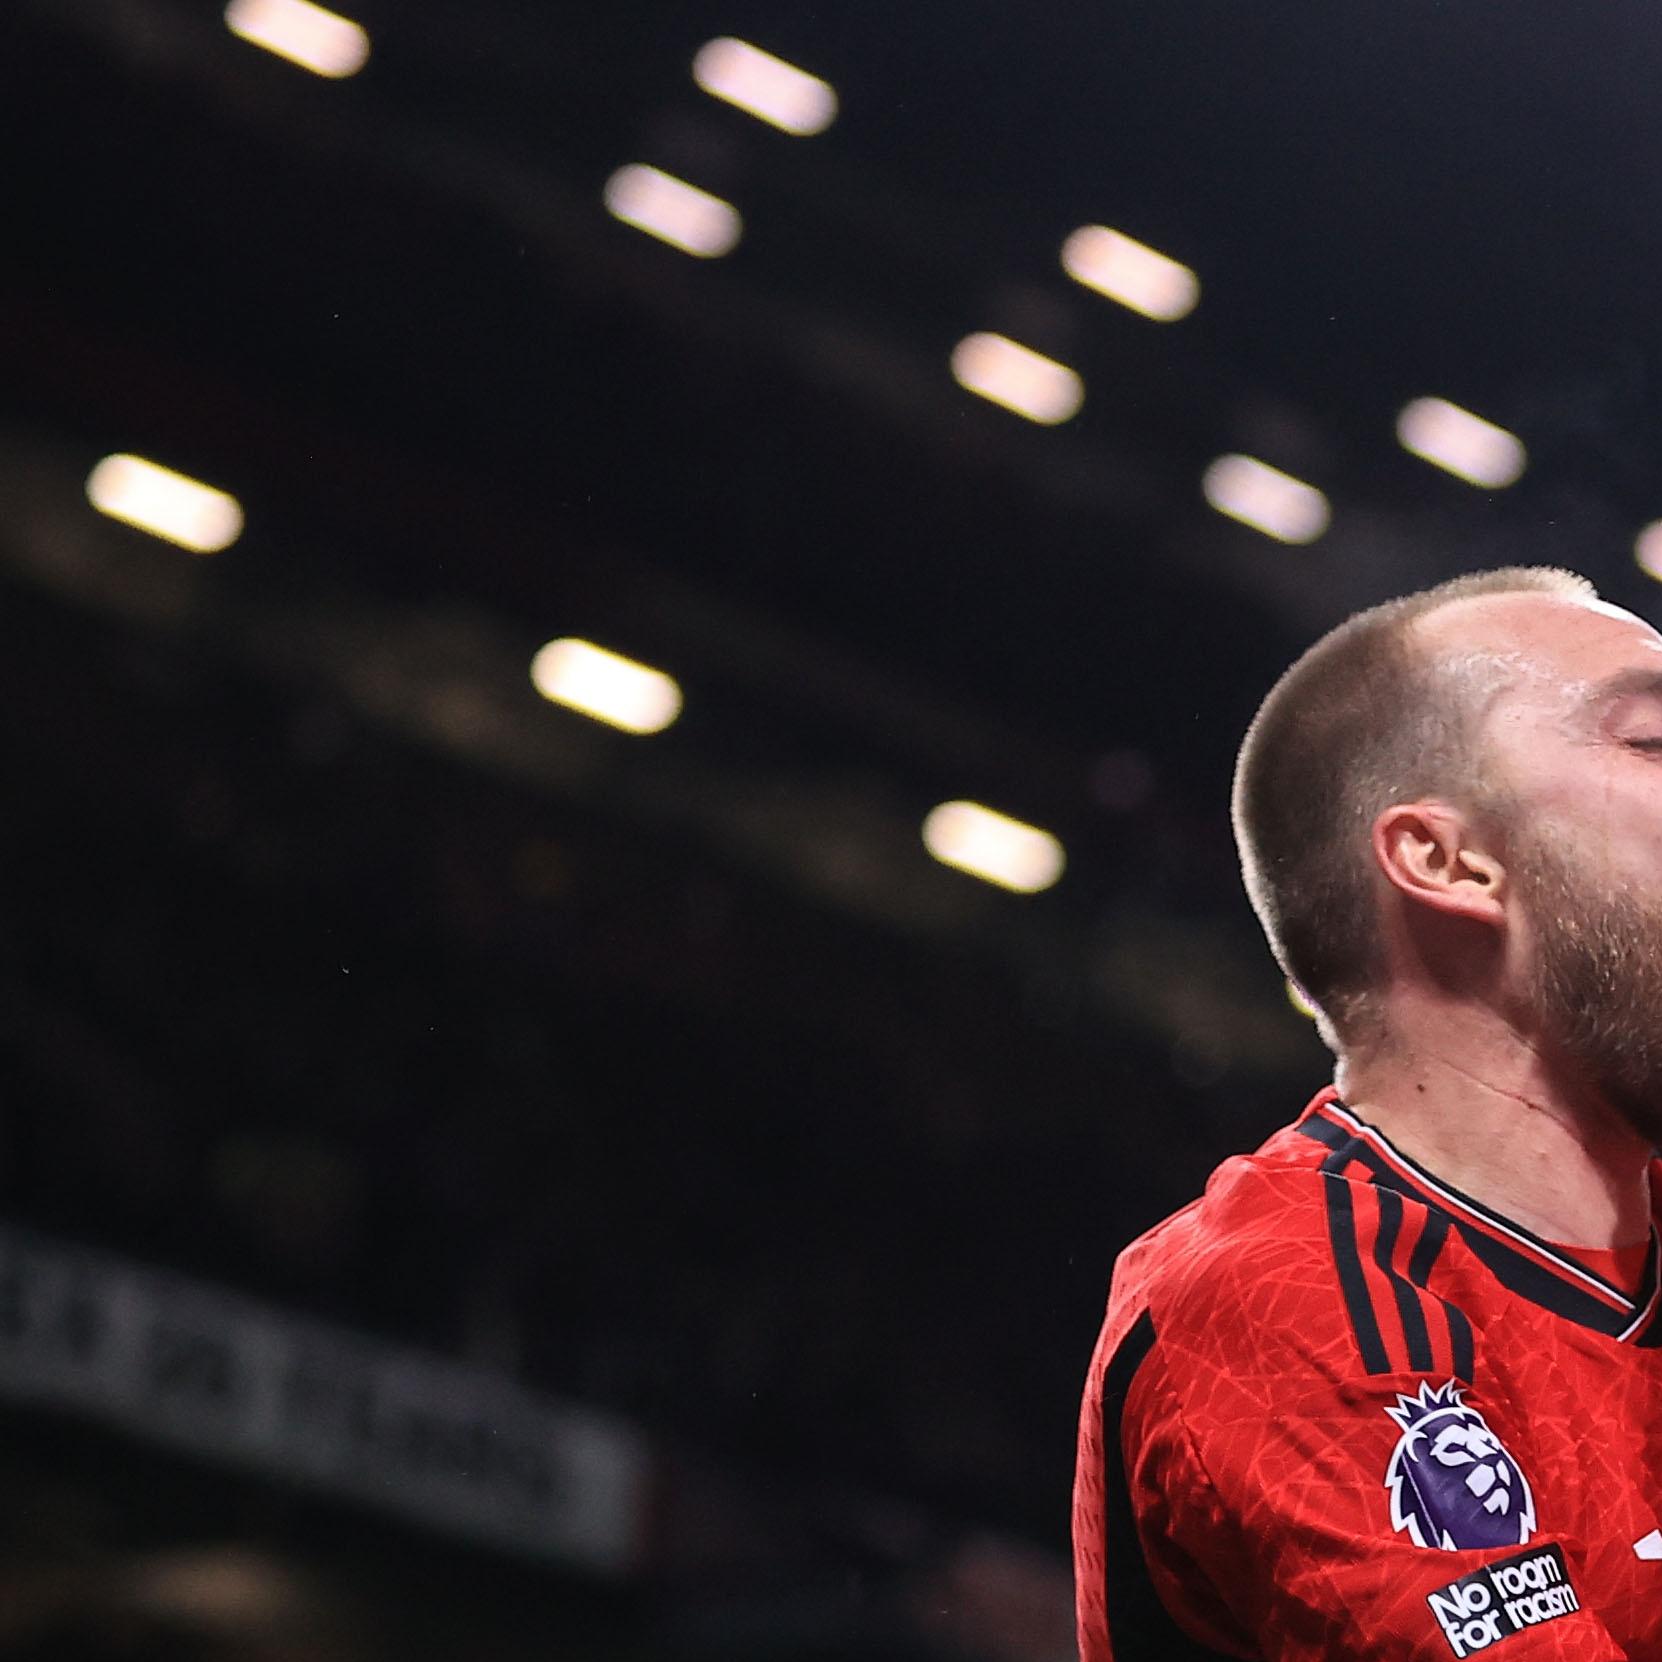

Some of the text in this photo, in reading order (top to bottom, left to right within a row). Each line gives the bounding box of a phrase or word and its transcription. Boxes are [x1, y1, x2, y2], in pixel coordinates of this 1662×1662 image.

[1427, 1554, 1562, 1629] No room
[1445, 1583, 1580, 1658] for racism
